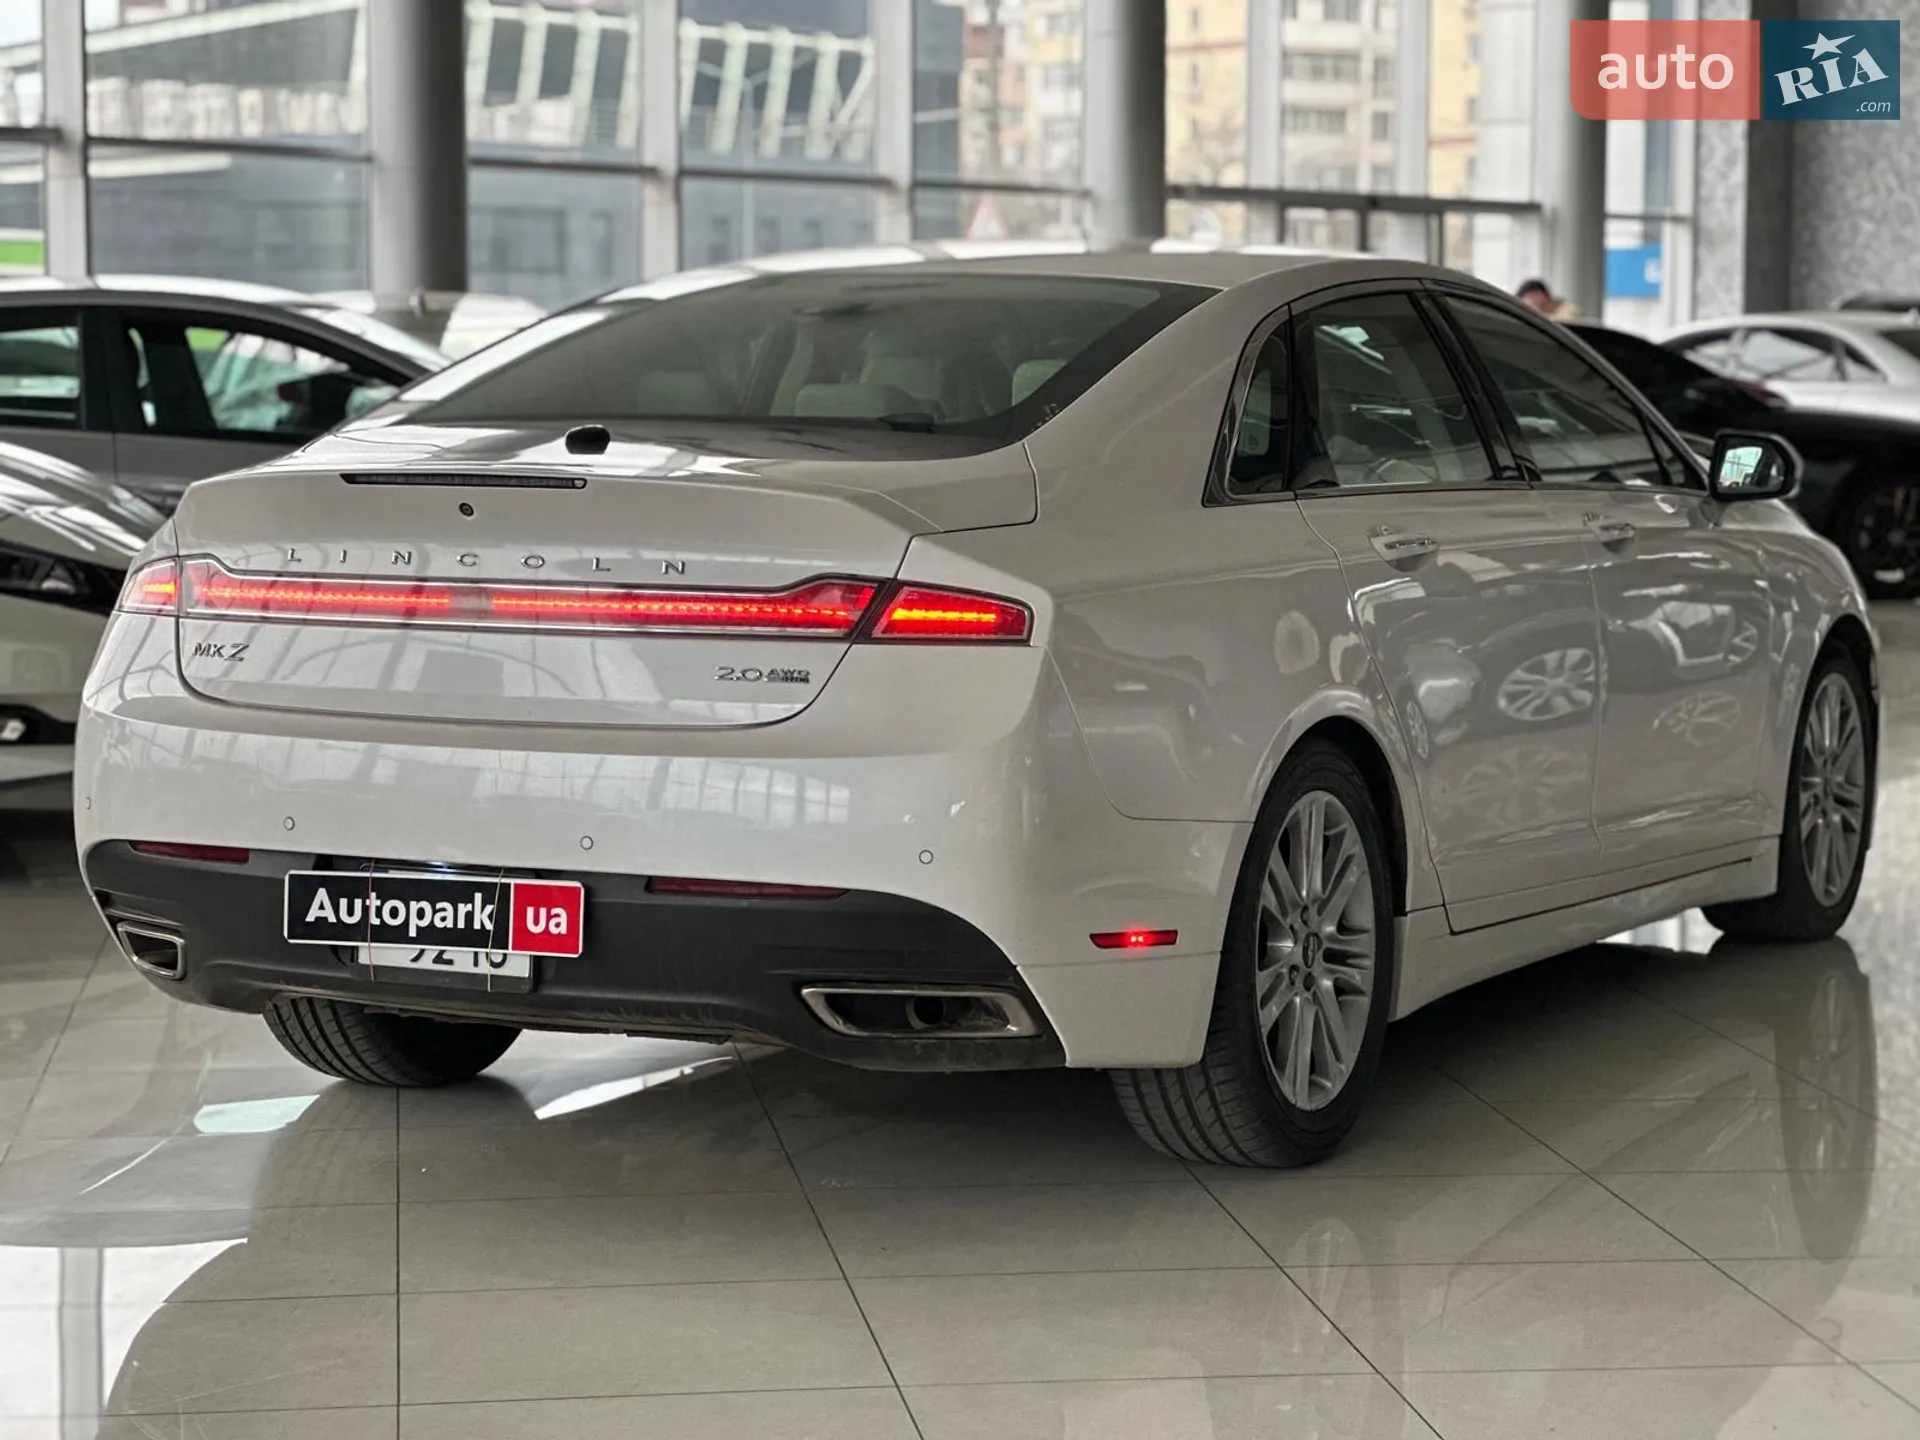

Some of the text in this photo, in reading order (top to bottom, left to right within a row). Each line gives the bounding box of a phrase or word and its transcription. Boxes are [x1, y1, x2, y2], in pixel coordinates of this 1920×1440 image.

[287, 548, 686, 576] LINCOLN
[193, 642, 250, 662] MKZ
[714, 666, 763, 682] 2.0
[305, 887, 568, 937] Autopark ua
